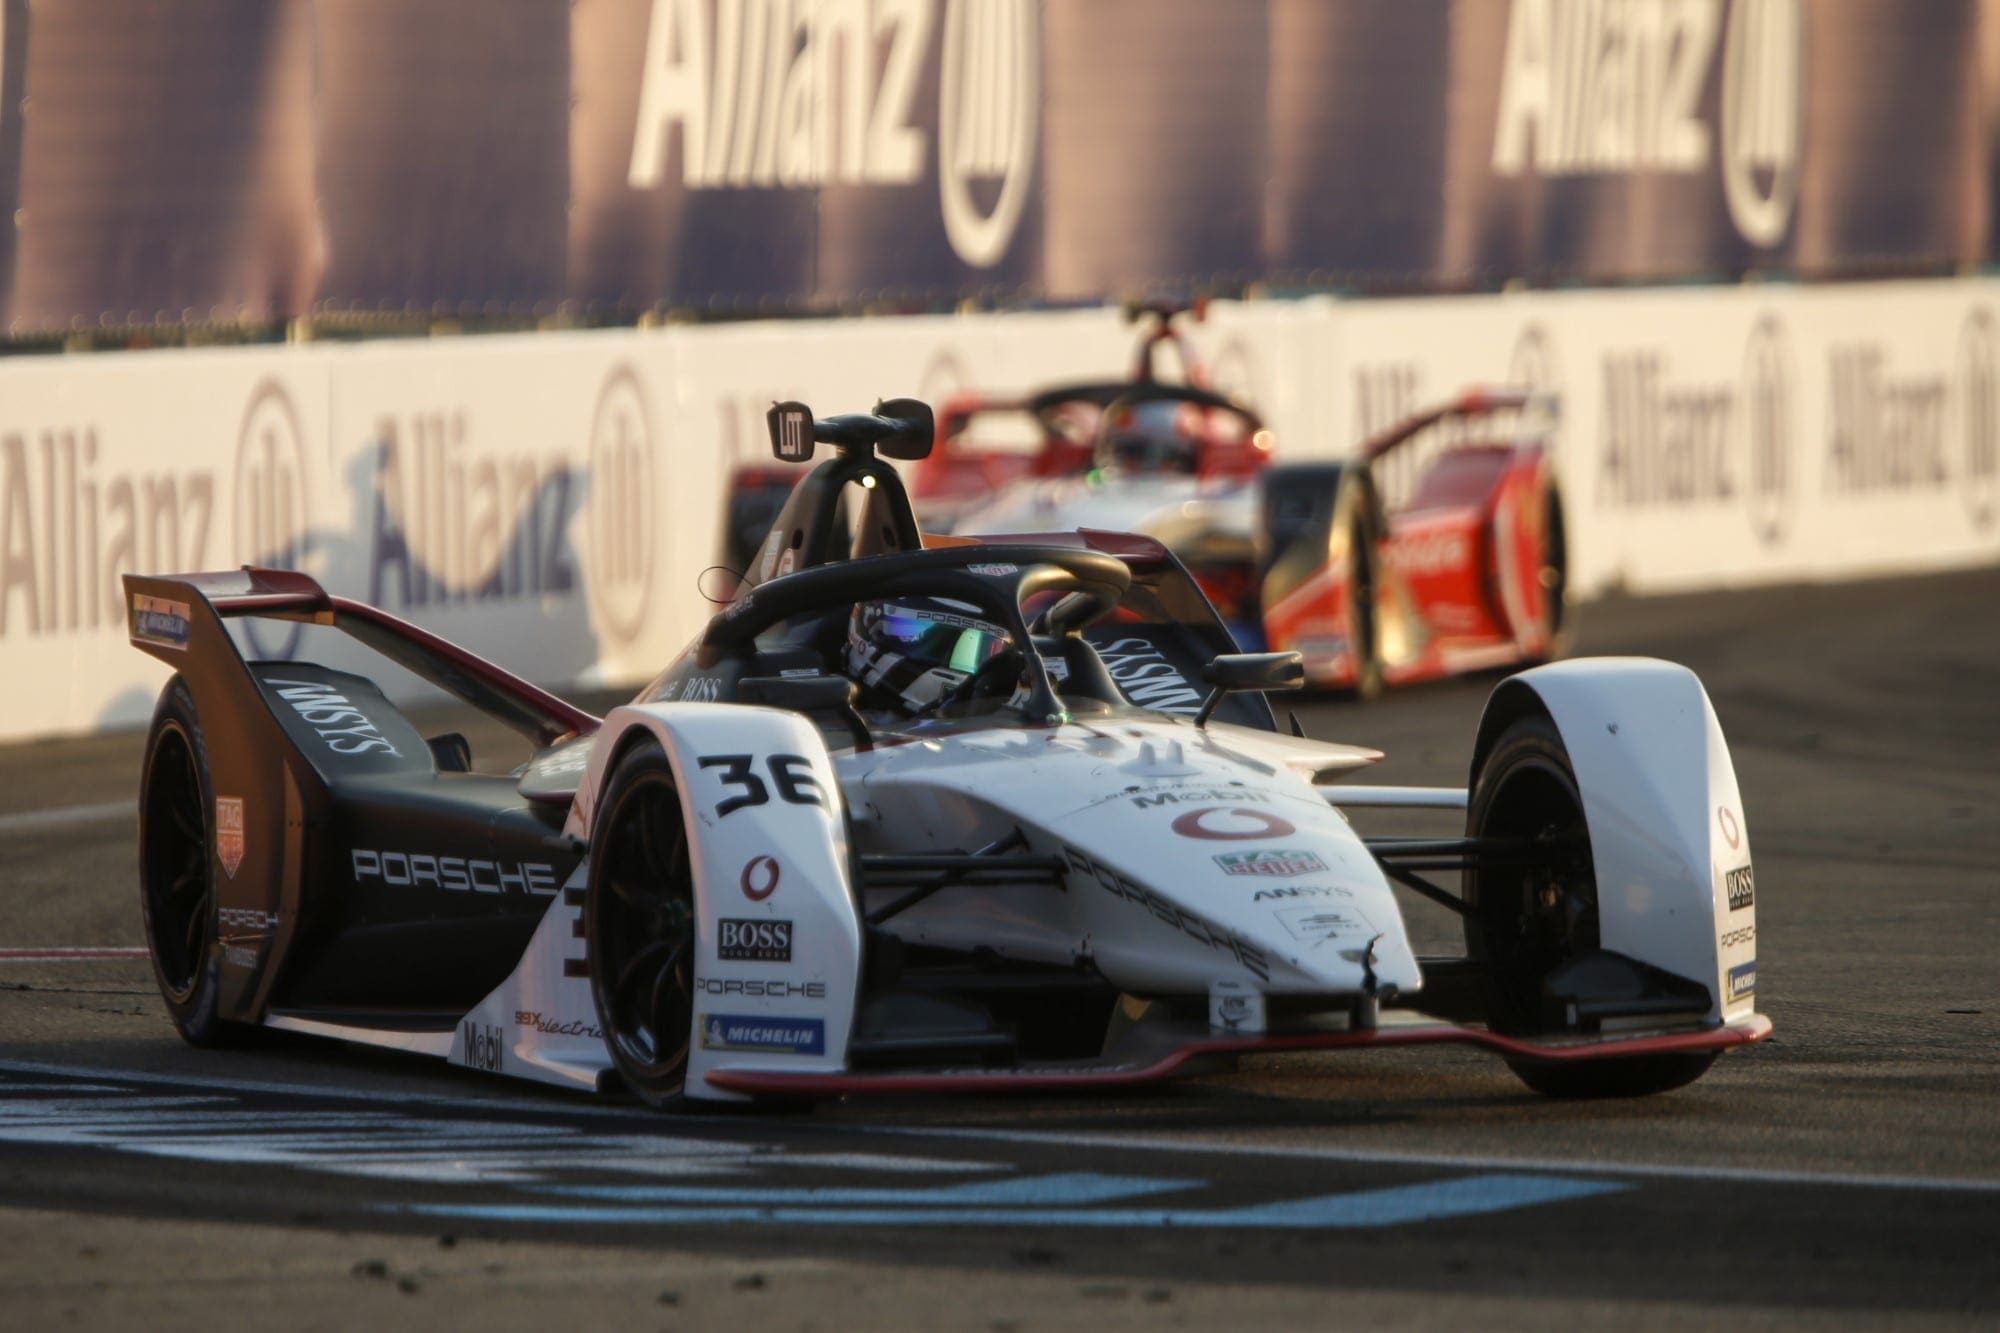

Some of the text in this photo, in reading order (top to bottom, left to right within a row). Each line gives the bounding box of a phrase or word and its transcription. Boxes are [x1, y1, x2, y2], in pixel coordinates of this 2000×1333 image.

[351, 849, 559, 896] PORSCHE
[1727, 868, 1753, 899] BOSS
[721, 922, 788, 949] BOSS
[696, 977, 825, 998] PORSCHE
[726, 1026, 814, 1045] MICHELIN
